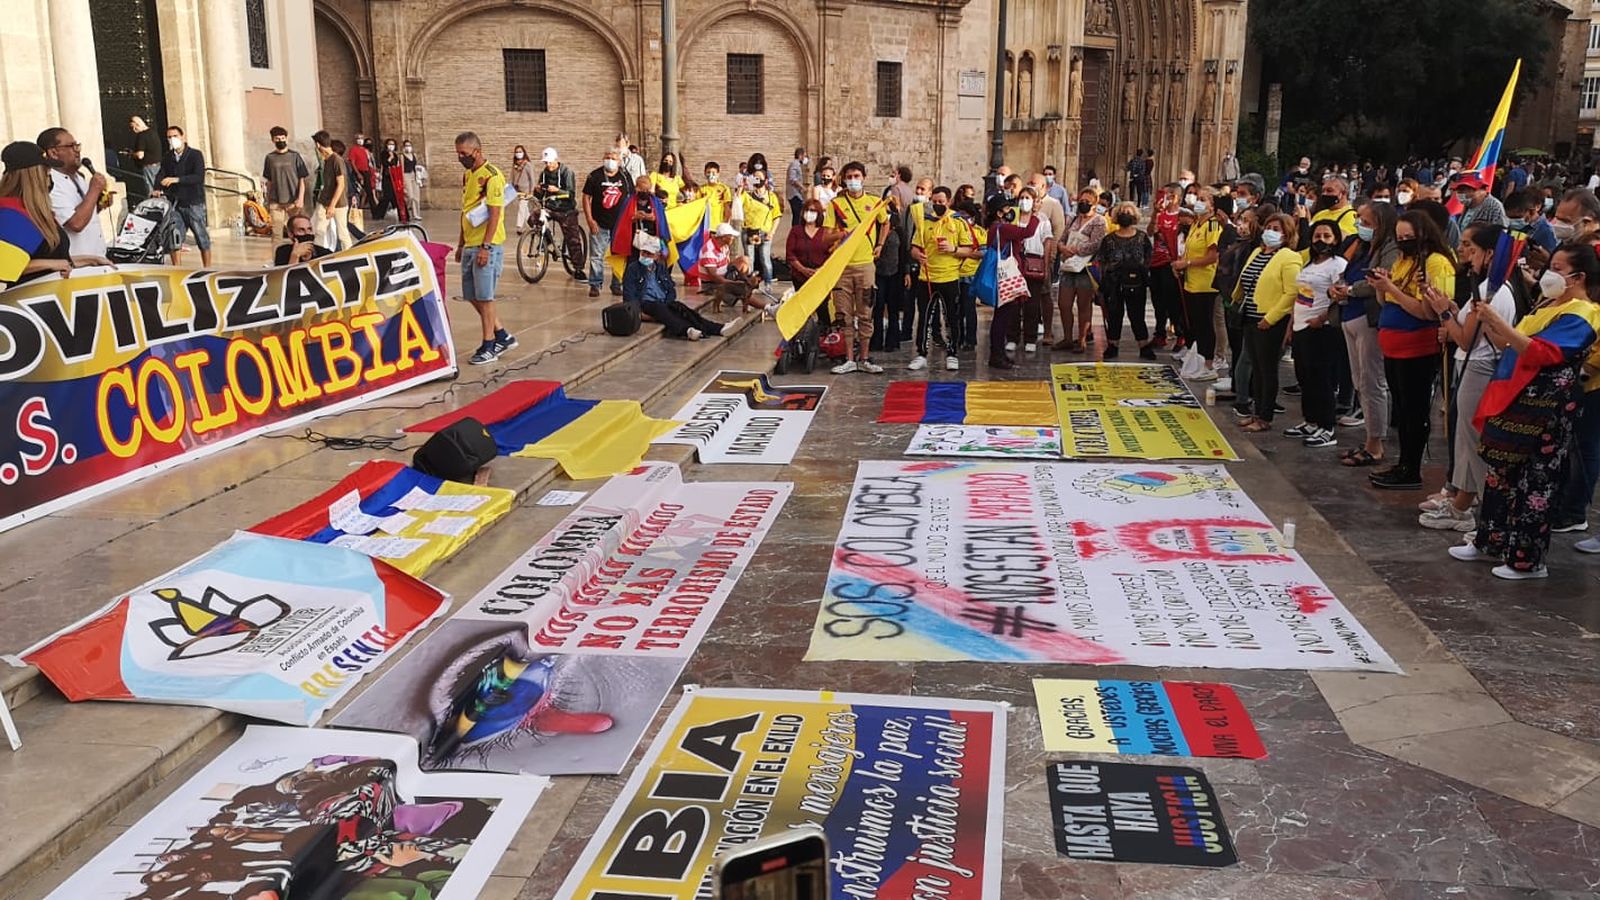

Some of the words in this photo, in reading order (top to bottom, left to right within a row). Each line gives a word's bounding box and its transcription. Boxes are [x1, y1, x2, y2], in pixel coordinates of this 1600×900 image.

[97, 302, 440, 458] COLOMBIA
[725, 416, 784, 456] MATANDO
[724, 488, 779, 536] ESTADO
[965, 472, 1033, 520] MATANDO
[618, 502, 685, 557] MATANDO
[711, 530, 752, 549] DE
[839, 474, 927, 568] COLOMBIA
[479, 514, 624, 616] COLOMBIA
[635, 550, 738, 650] TERRORISMO
[280, 649, 310, 672] Conflicto
[307, 631, 332, 653] Armado
[337, 607, 365, 629] Colombia
[323, 635, 349, 654] España
[577, 615, 640, 650] NO
[300, 624, 400, 698] PRESENTE
[761, 714, 804, 754] EXILIO
[877, 715, 923, 759] paz,
[922, 714, 968, 779] social!
[1145, 718, 1179, 757] MUCHAS
[742, 775, 780, 796] EN
[752, 757, 788, 773] EL
[800, 711, 865, 816] mensajeros
[854, 759, 904, 782] la
[1056, 763, 1101, 794] QUE
[904, 783, 974, 878] justicia
[1062, 804, 1115, 858] HASTA
[1107, 791, 1160, 833] HAYA
[1155, 775, 1223, 854] JUSTICIA
